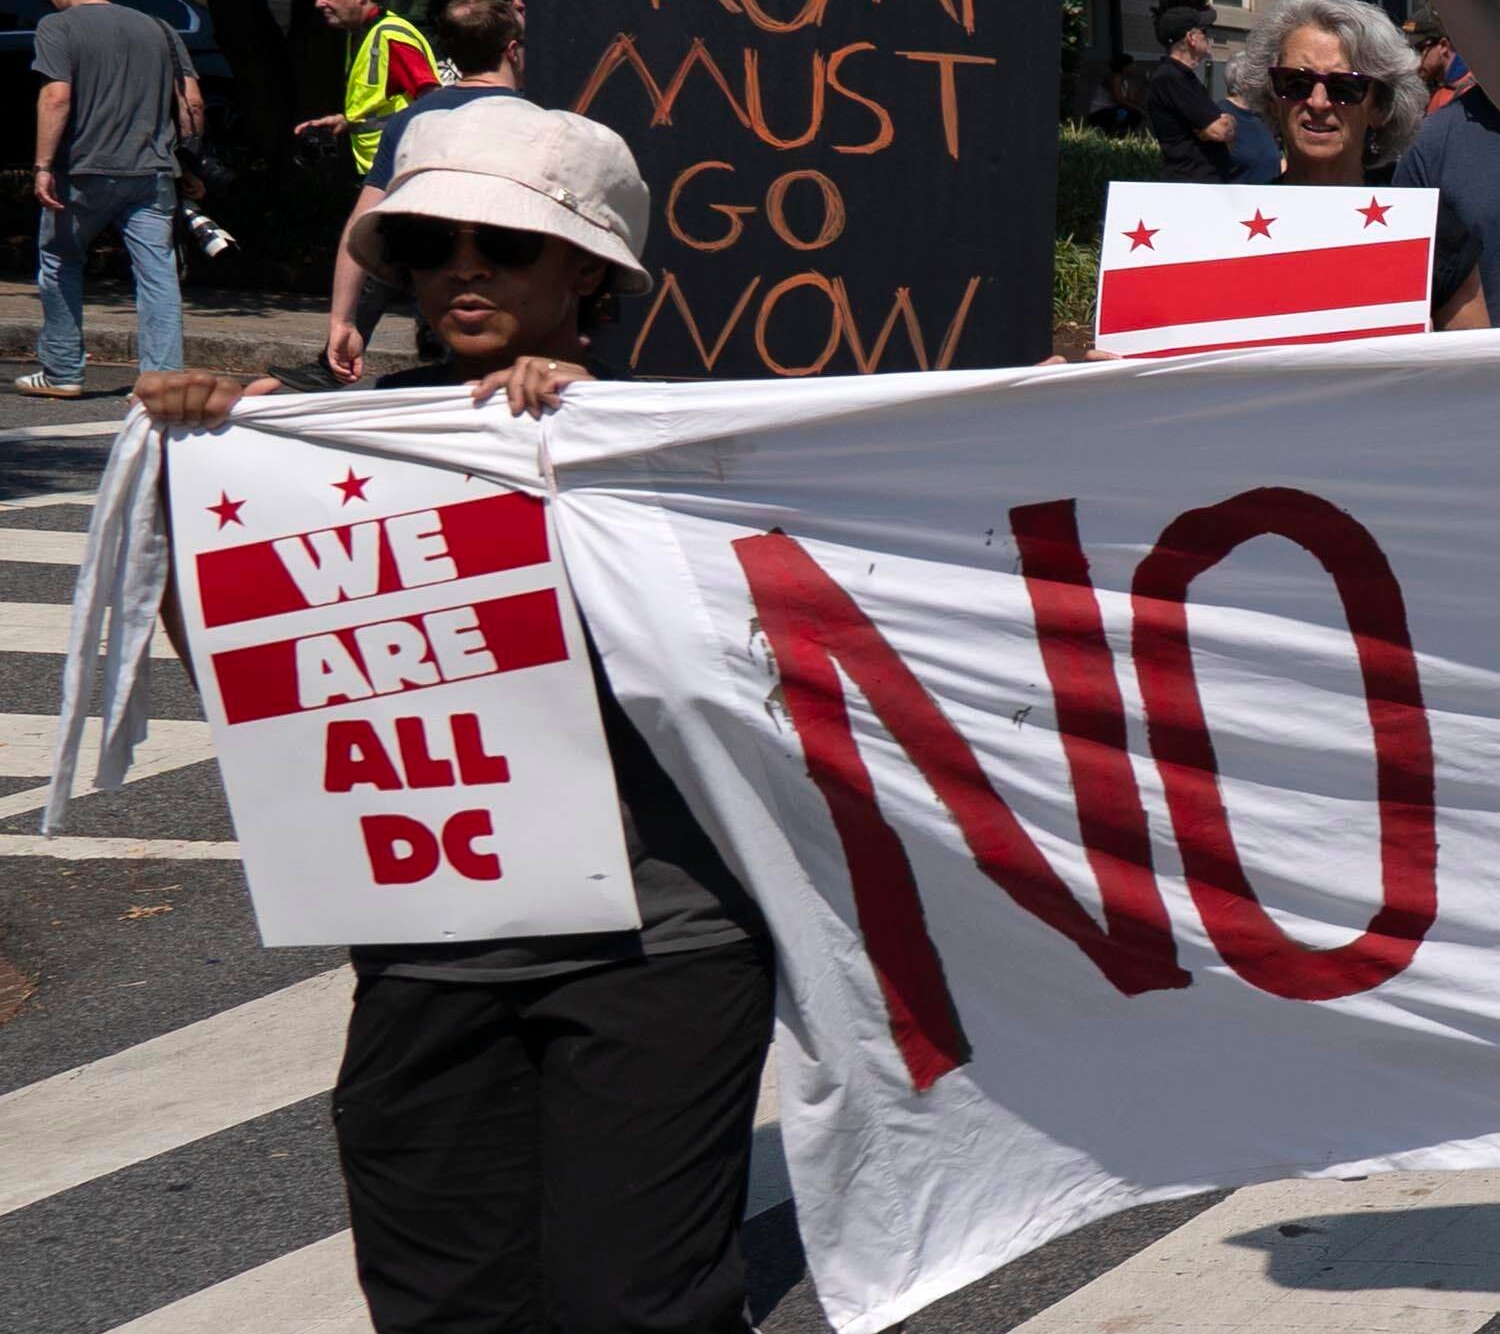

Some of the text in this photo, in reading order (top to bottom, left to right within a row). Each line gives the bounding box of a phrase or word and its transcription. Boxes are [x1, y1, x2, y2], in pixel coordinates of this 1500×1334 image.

[572, 33, 997, 159] MUST
[667, 161, 847, 251] GO
[632, 270, 981, 376] NOW
[273, 509, 458, 607] WE
[295, 605, 499, 709] ARE
[323, 712, 511, 794] ALL
[732, 482, 1440, 1091] NO
[359, 808, 503, 886] DC
